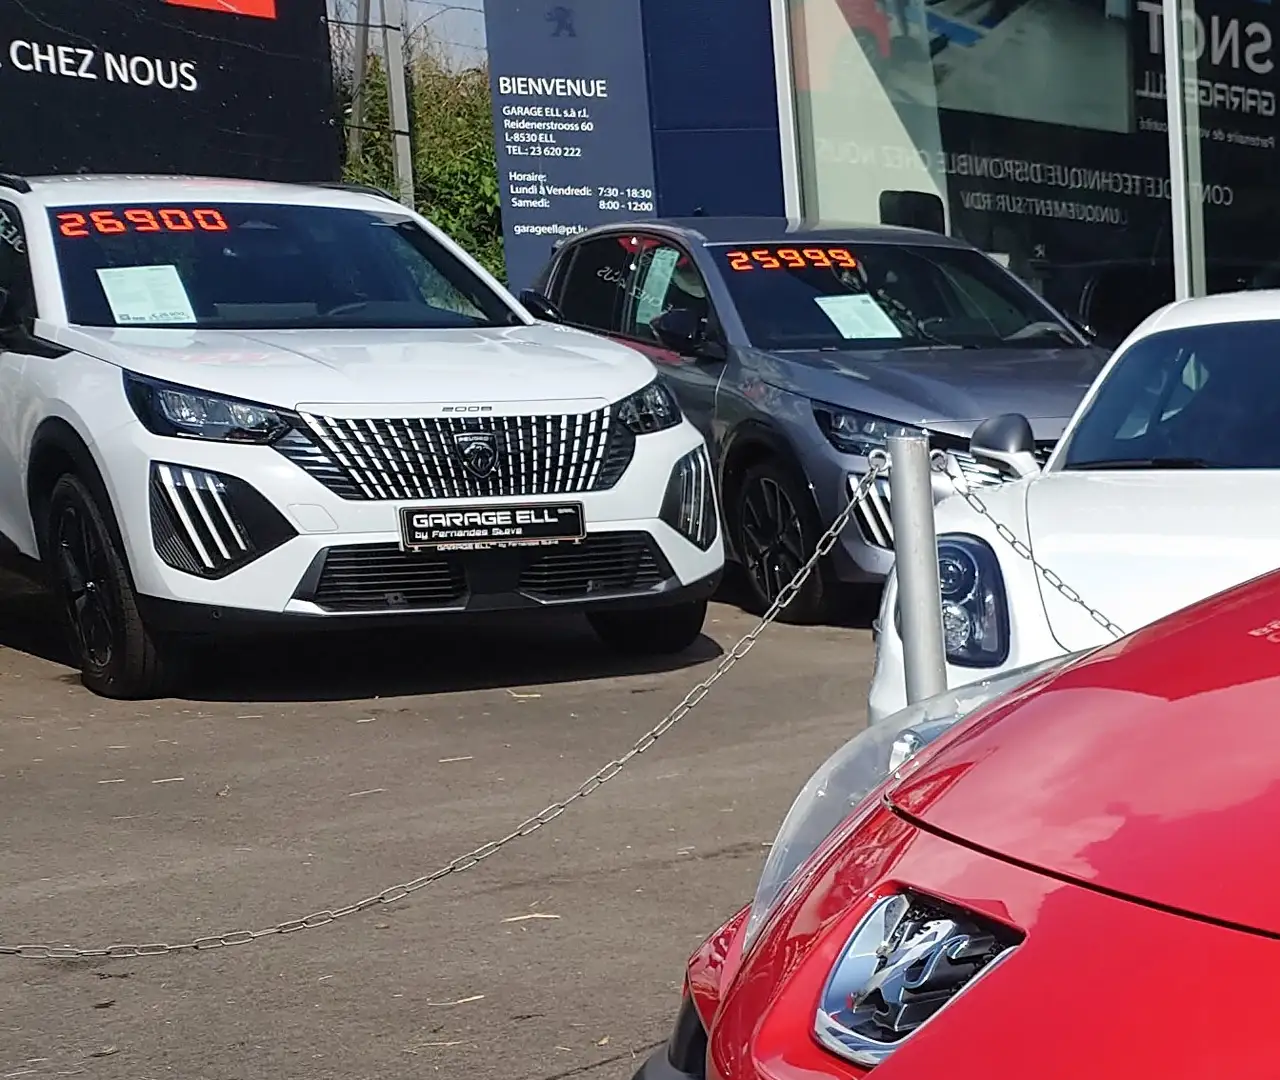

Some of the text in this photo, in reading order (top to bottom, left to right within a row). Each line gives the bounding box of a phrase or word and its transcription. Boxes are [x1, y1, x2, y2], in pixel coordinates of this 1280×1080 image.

[9, 40, 198, 91] CHEZ NOUS
[499, 76, 608, 98] BIENVENUE
[503, 106, 544, 117] GARAGE
[545, 107, 562, 117] ELL
[504, 120, 594, 131] Reidenerstrooss 60
[505, 133, 556, 143] L-8530 ELL
[529, 146, 542, 156] 23
[543, 147, 562, 156] 620
[563, 148, 581, 157] 222
[509, 172, 547, 181] Horaire:
[510, 184, 537, 195] Lundi
[546, 186, 592, 196] Vendredi:
[598, 187, 618, 197] 7:30
[627, 188, 652, 198] 18:30
[511, 198, 550, 208] Samedi:
[599, 201, 619, 210] 8:00
[627, 201, 653, 211] 12:00
[56, 208, 229, 236] 26900
[725, 248, 857, 271] 25999
[412, 511, 512, 528] GARAGE
[515, 509, 559, 525] ELL
[414, 526, 522, 540] by Fernandes Steve
